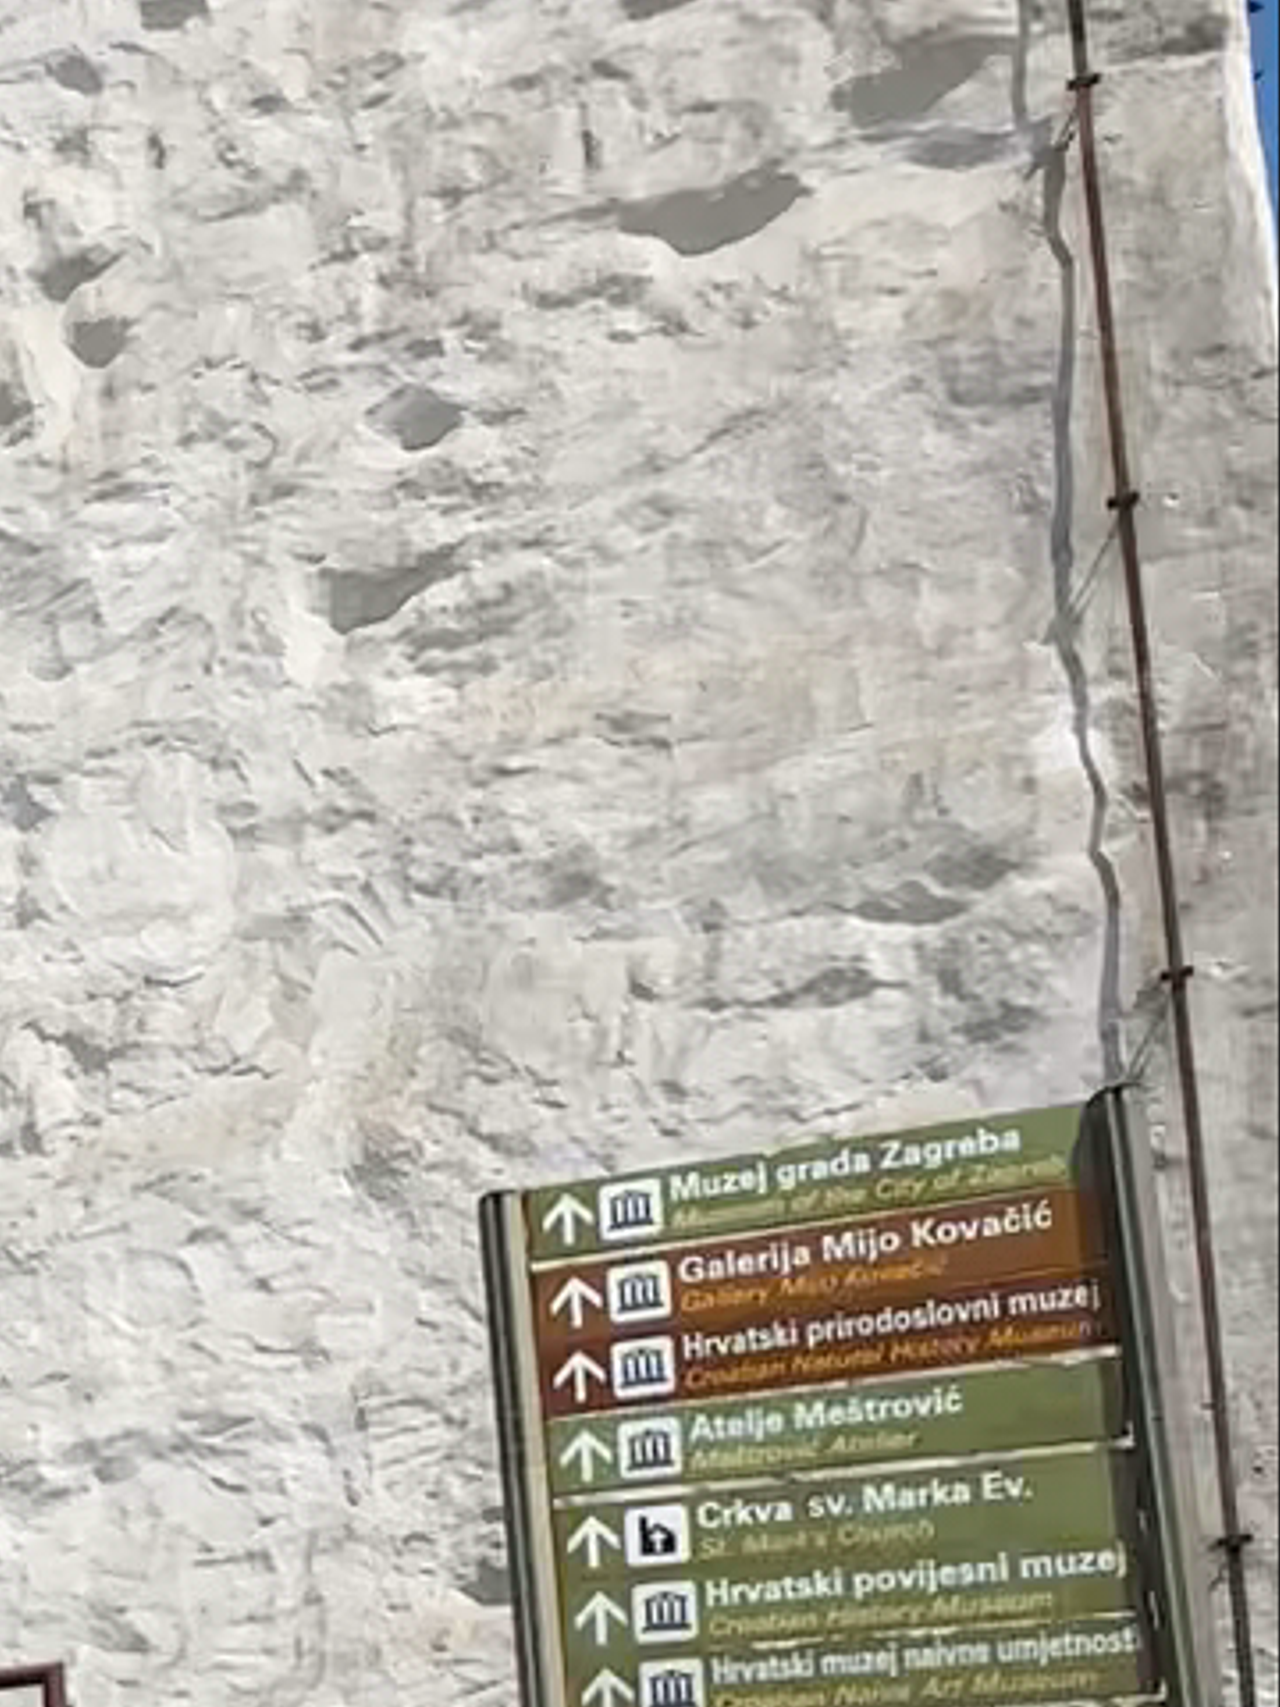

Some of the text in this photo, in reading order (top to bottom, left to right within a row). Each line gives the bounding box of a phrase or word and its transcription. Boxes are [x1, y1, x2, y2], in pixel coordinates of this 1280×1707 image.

[669, 1127, 1022, 1201] Muzej grada Zagreba
[679, 1199, 1053, 1284] Galerija Mijo Kovačić
[682, 1279, 1101, 1360] Hrvatski prirodoslovni muzej
[690, 1384, 963, 1441] Atelje Meštrović
[696, 1469, 1034, 1529] Crkva sv. Marka Ev.
[705, 1538, 1127, 1608] Hrvatski povijesni muzej
[711, 1648, 815, 1684] Hrvatski
[820, 1640, 899, 1678] muzej
